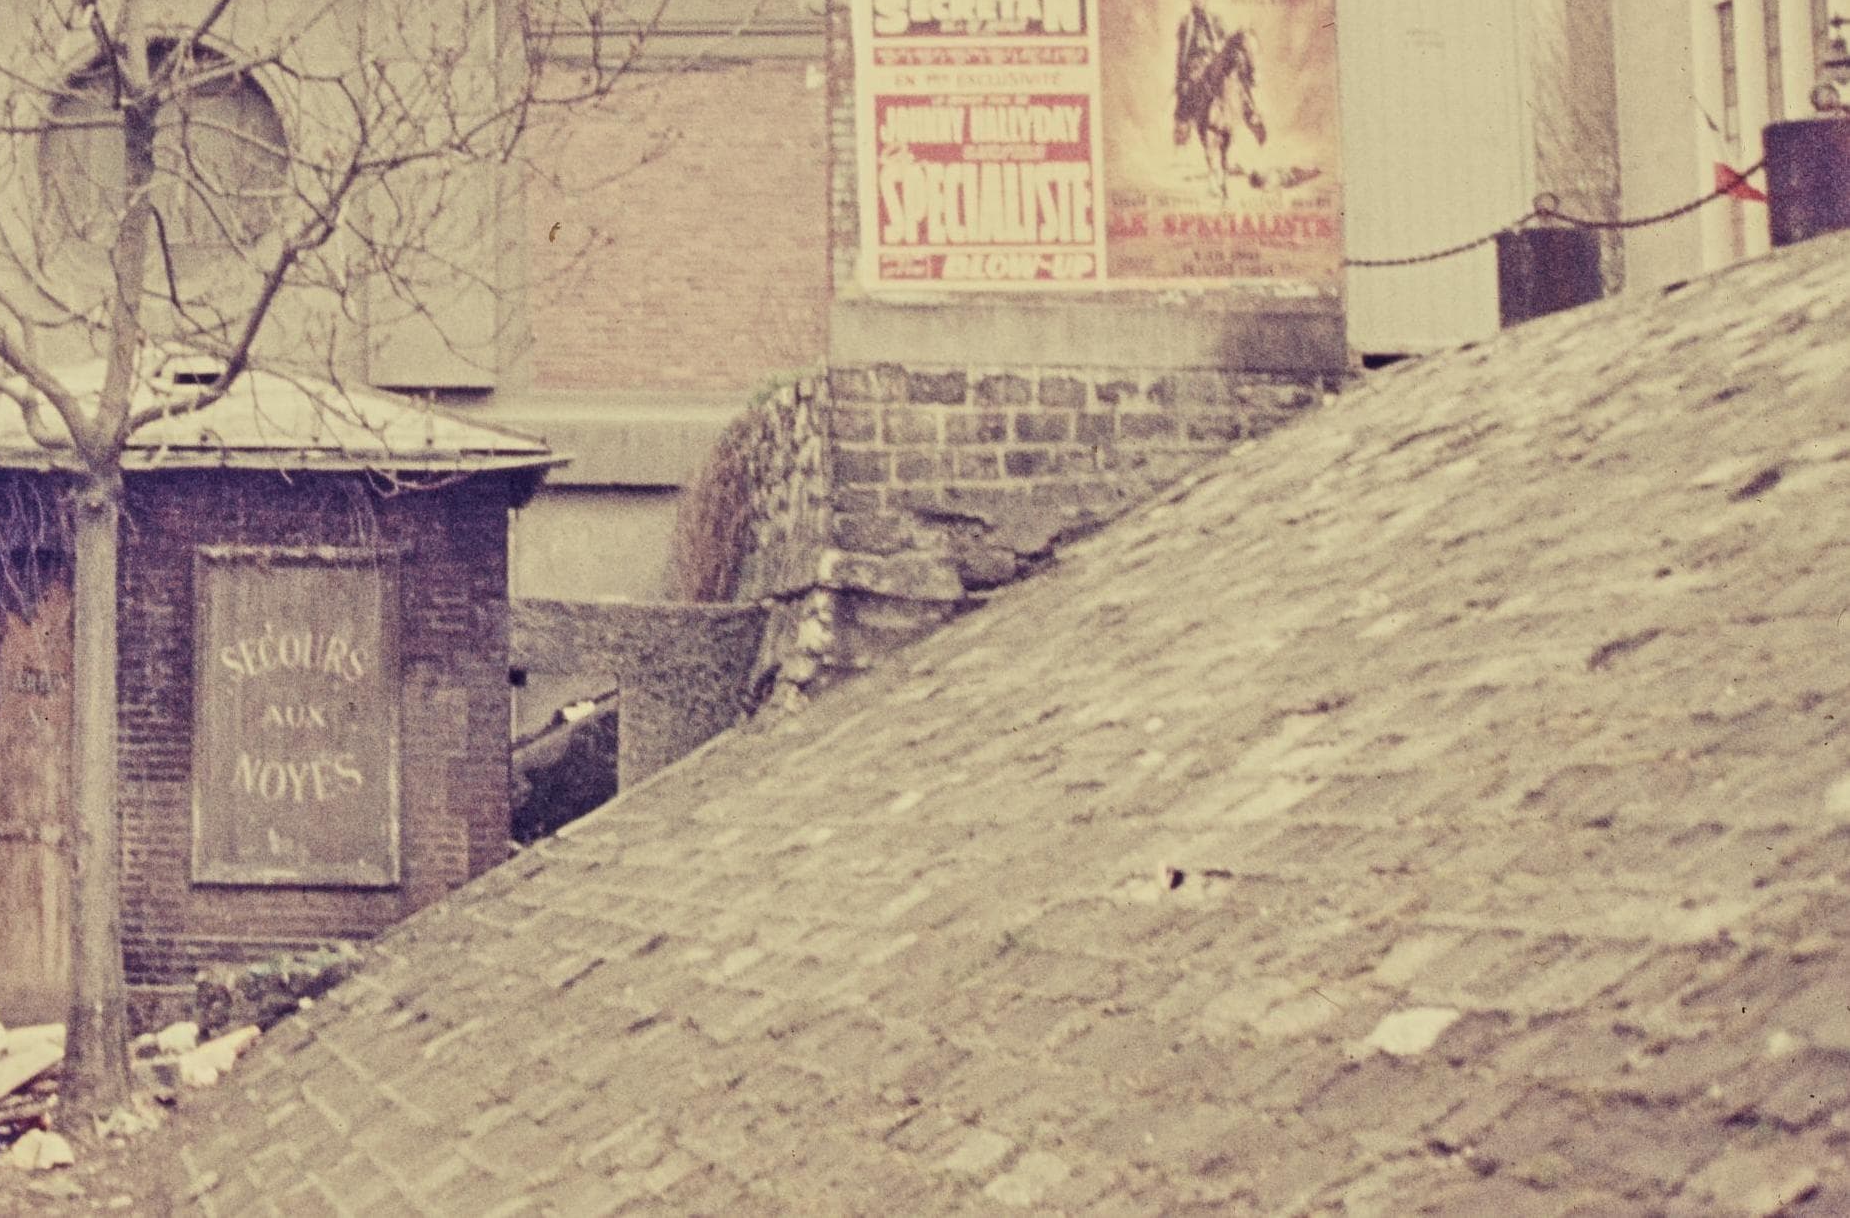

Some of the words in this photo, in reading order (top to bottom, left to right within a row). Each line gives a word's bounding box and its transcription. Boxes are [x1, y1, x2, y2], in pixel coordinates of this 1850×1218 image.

[970, 106, 1084, 143] HALLYDAY
[880, 162, 1093, 243] SPECIALISTE
[264, 705, 326, 729] AUX
